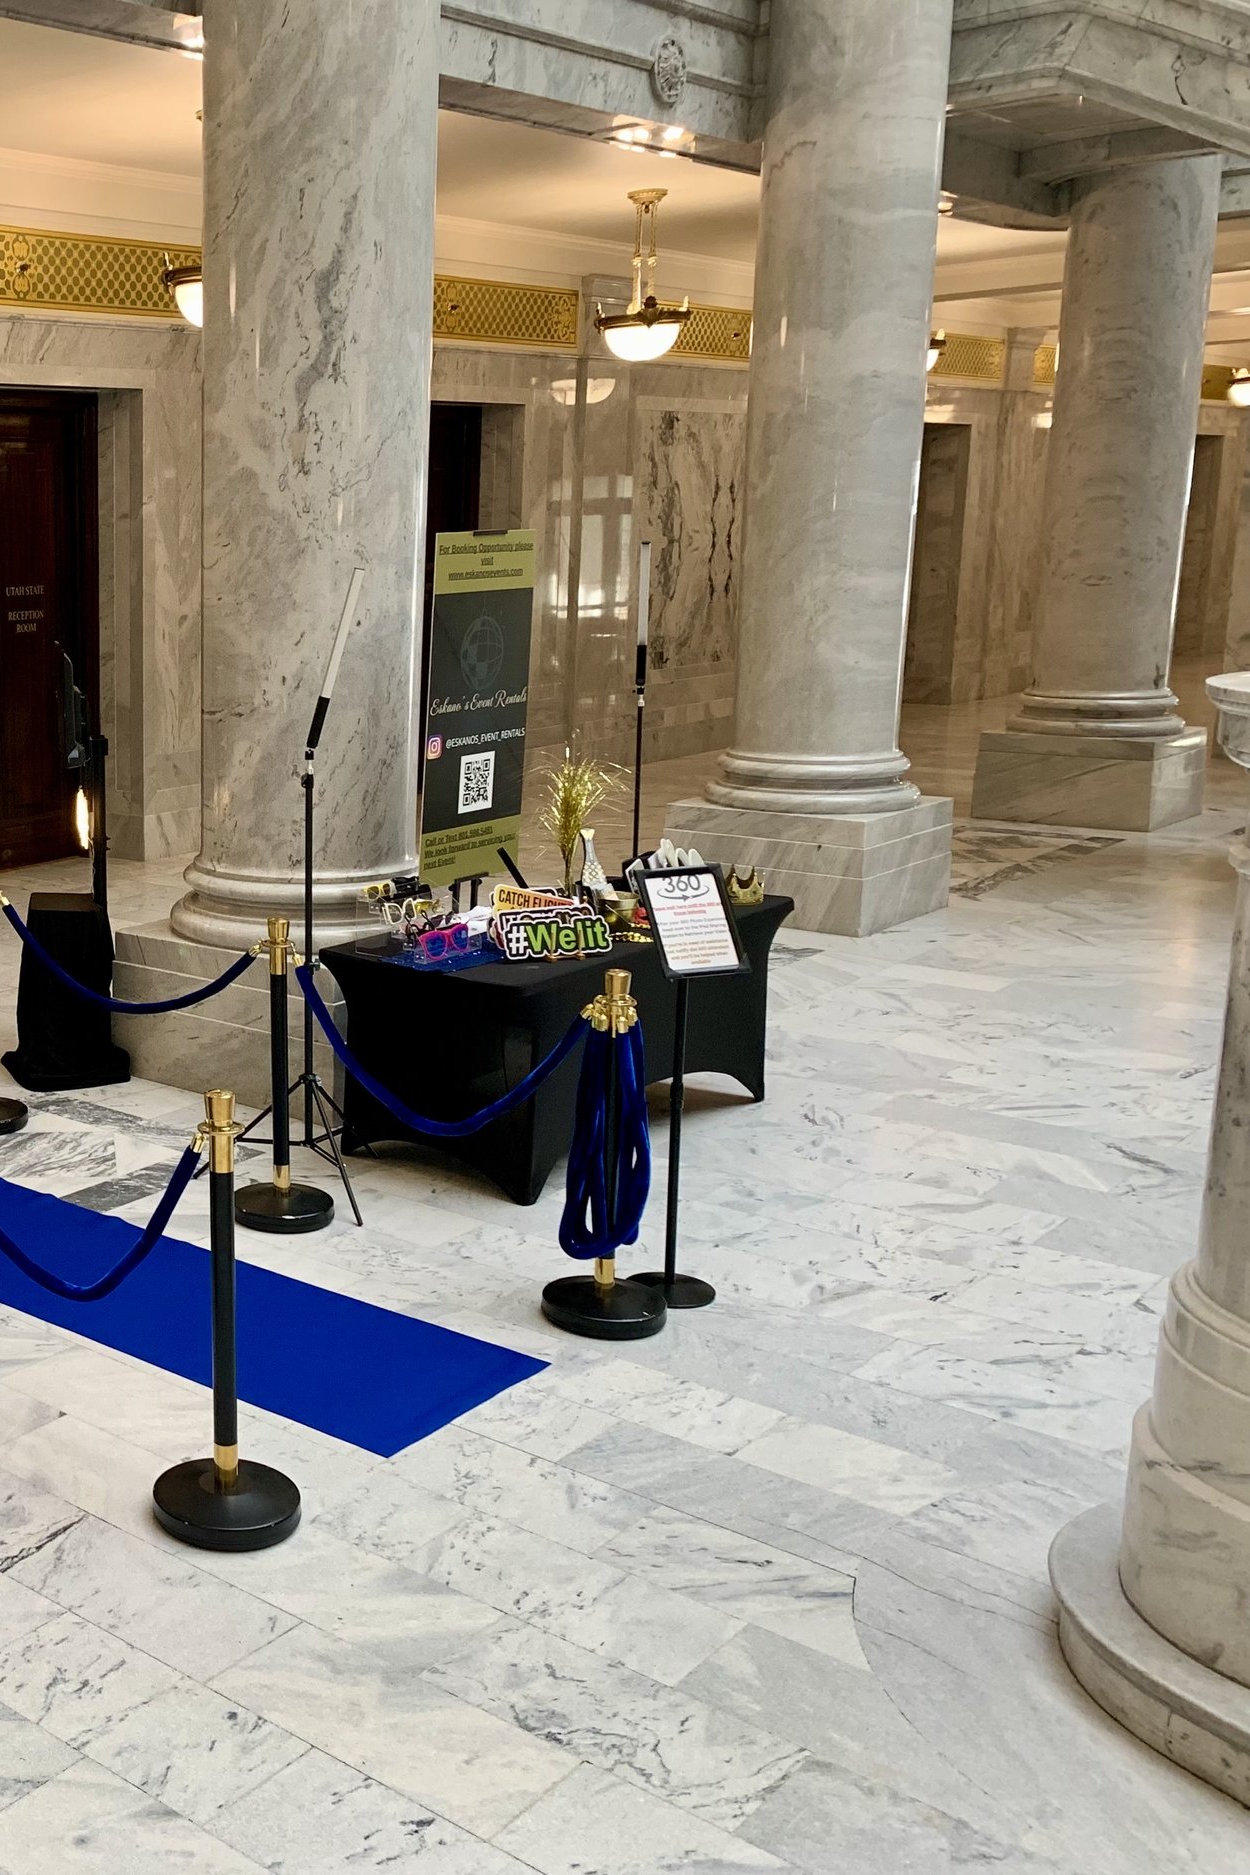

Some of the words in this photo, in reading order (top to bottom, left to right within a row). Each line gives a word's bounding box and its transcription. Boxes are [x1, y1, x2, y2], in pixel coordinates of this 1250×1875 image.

[439, 545, 450, 555] For
[452, 543, 477, 554] Booking
[478, 542, 514, 554] Opportunity
[515, 541, 534, 552] please
[480, 557, 494, 566] visit
[5, 586, 24, 596] UTAH
[25, 585, 45, 595] STATE
[8, 610, 44, 621] RECEPTION
[16, 623, 37, 633] ROOM
[430, 695, 469, 716] Eskano's
[470, 693, 494, 711] Event
[494, 686, 527, 708] Rentals
[445, 728, 526, 749] @ESKANOS_EVENT_RENTALS
[425, 837, 436, 847] Call
[661, 875, 701, 893] 360
[498, 889, 530, 909] CATCH
